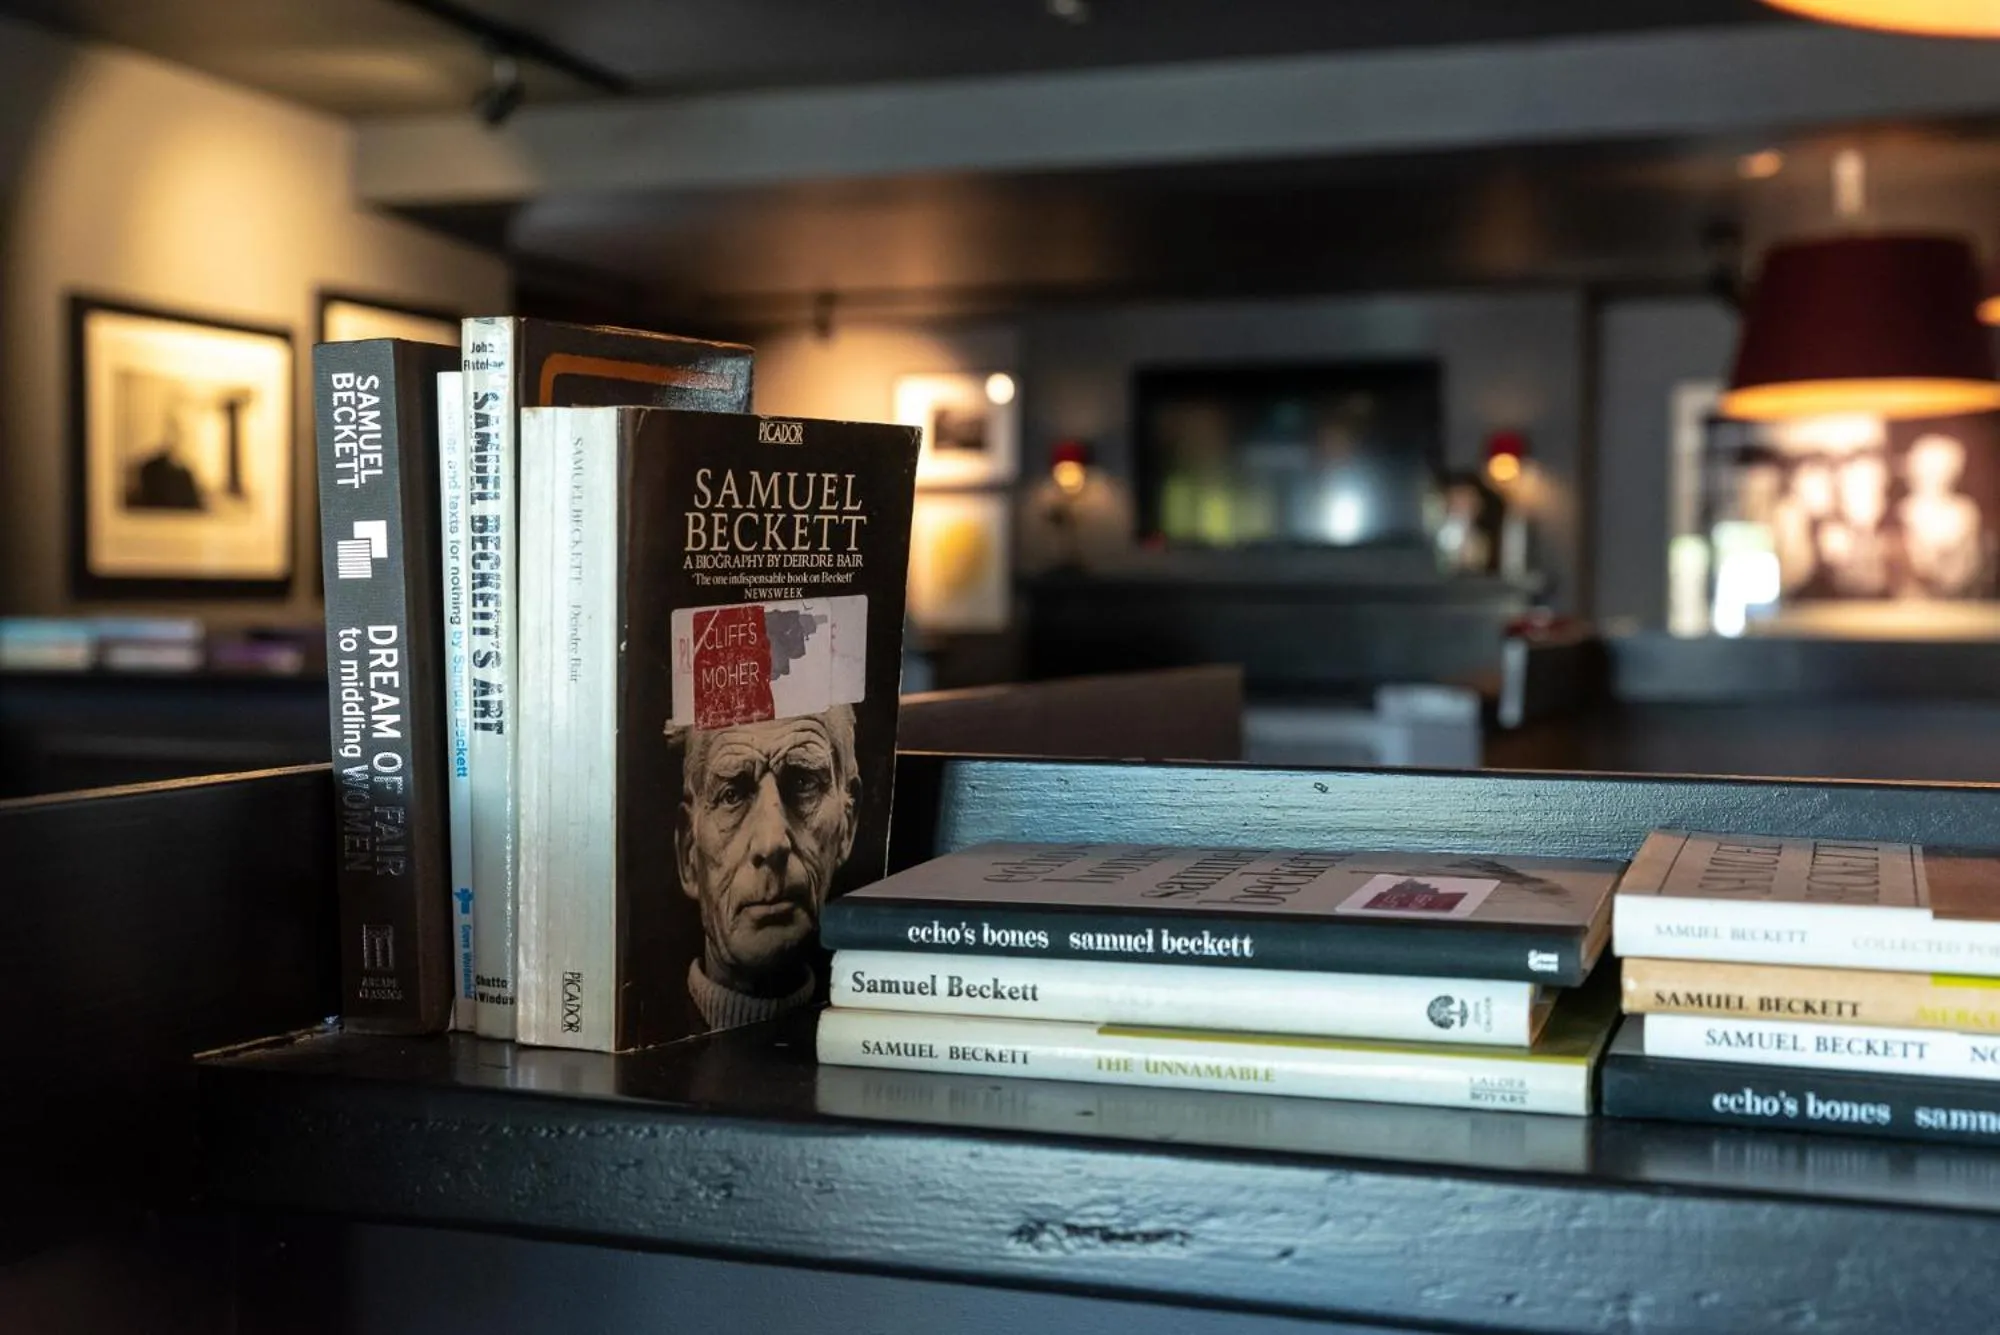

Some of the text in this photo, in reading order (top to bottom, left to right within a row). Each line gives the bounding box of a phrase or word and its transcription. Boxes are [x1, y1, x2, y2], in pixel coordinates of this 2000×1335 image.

[332, 372, 360, 489] BECKETT
[356, 374, 384, 485] SAMUEL
[759, 421, 803, 444] PICADOR
[470, 391, 501, 506] SAMUEL
[570, 437, 584, 505] SAMUEL
[693, 468, 863, 511] SAMUEL
[448, 495, 462, 535] texts
[684, 511, 868, 551] BECKETT
[449, 538, 463, 563] for
[683, 554, 864, 569] A BIOGRAPHY BY DEIRDRE BAIR
[449, 566, 464, 626] nothing
[712, 575, 728, 585] one
[728, 571, 786, 588] indispensable
[787, 571, 808, 584] book
[809, 574, 820, 583] on
[744, 587, 803, 600] NEWSWEEK
[451, 630, 464, 650] by
[703, 622, 758, 650] CLIFFS
[701, 661, 760, 694] MOHER
[473, 678, 504, 736] ART
[338, 627, 373, 872] to middling WOMEN
[367, 624, 408, 877] DREAM OF FAIR
[907, 919, 1254, 958] echo's bones samuel beckett
[1654, 922, 1724, 941] SAMUEL
[1730, 925, 1808, 944] BECKETT
[563, 971, 582, 1033] PICADOR
[851, 970, 1039, 1002] Samuel Beckett
[1654, 990, 1748, 1012] SAMUEL
[1758, 996, 1862, 1018] BECKETT
[861, 1039, 1030, 1066] SAMUEL BECKETT
[1704, 1028, 1806, 1052] SAMUEL
[1815, 1036, 1929, 1061] BECKETT
[1096, 1056, 1276, 1083] THE UNNAMABLE
[1712, 1087, 2000, 1134] echo's bones samu
